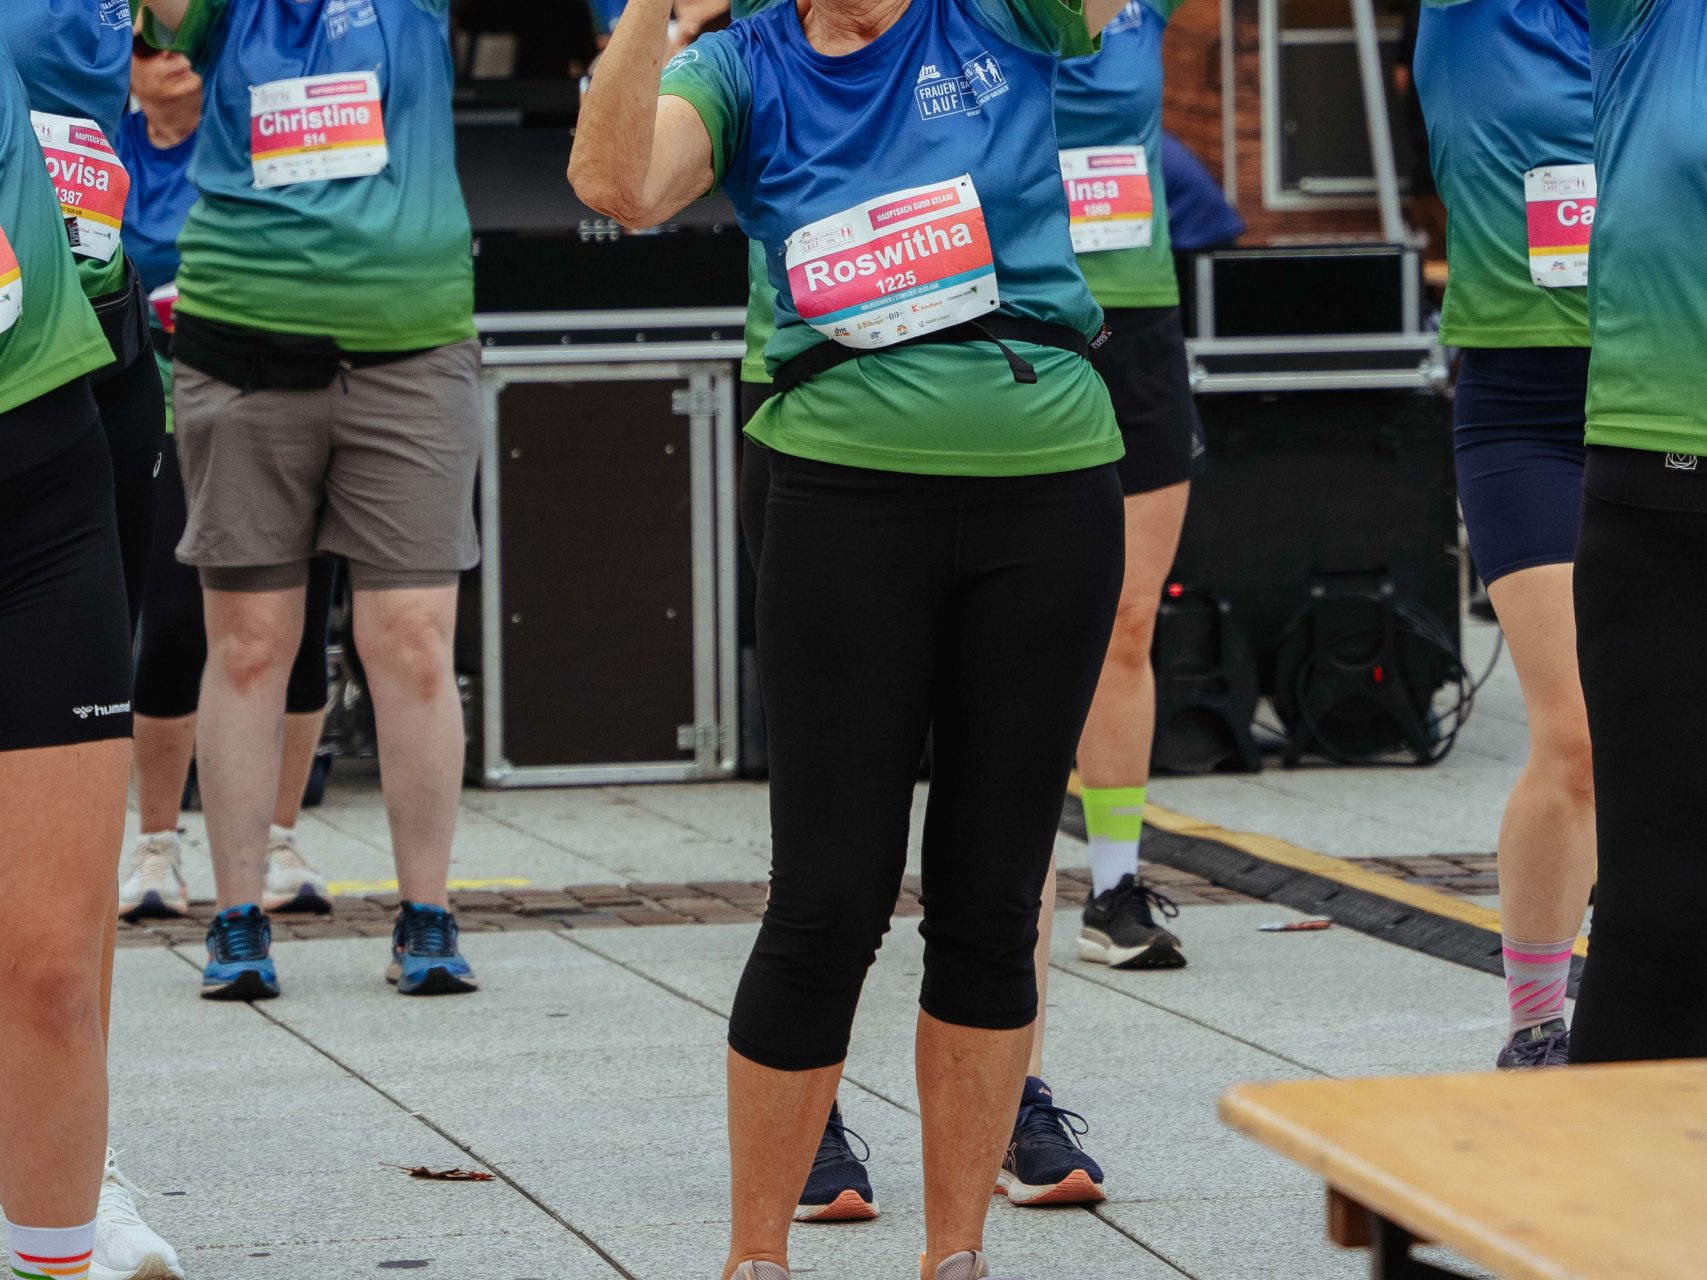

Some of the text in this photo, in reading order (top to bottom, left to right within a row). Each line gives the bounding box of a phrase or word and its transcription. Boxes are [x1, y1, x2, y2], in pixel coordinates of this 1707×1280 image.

[920, 82, 956, 101] FRAUEN
[923, 94, 958, 116] LAUF
[259, 104, 370, 136] Christine
[1068, 179, 1119, 202] Insa
[1557, 200, 1596, 226] Ca
[804, 222, 973, 293] Roswitha
[876, 270, 917, 295] 1225
